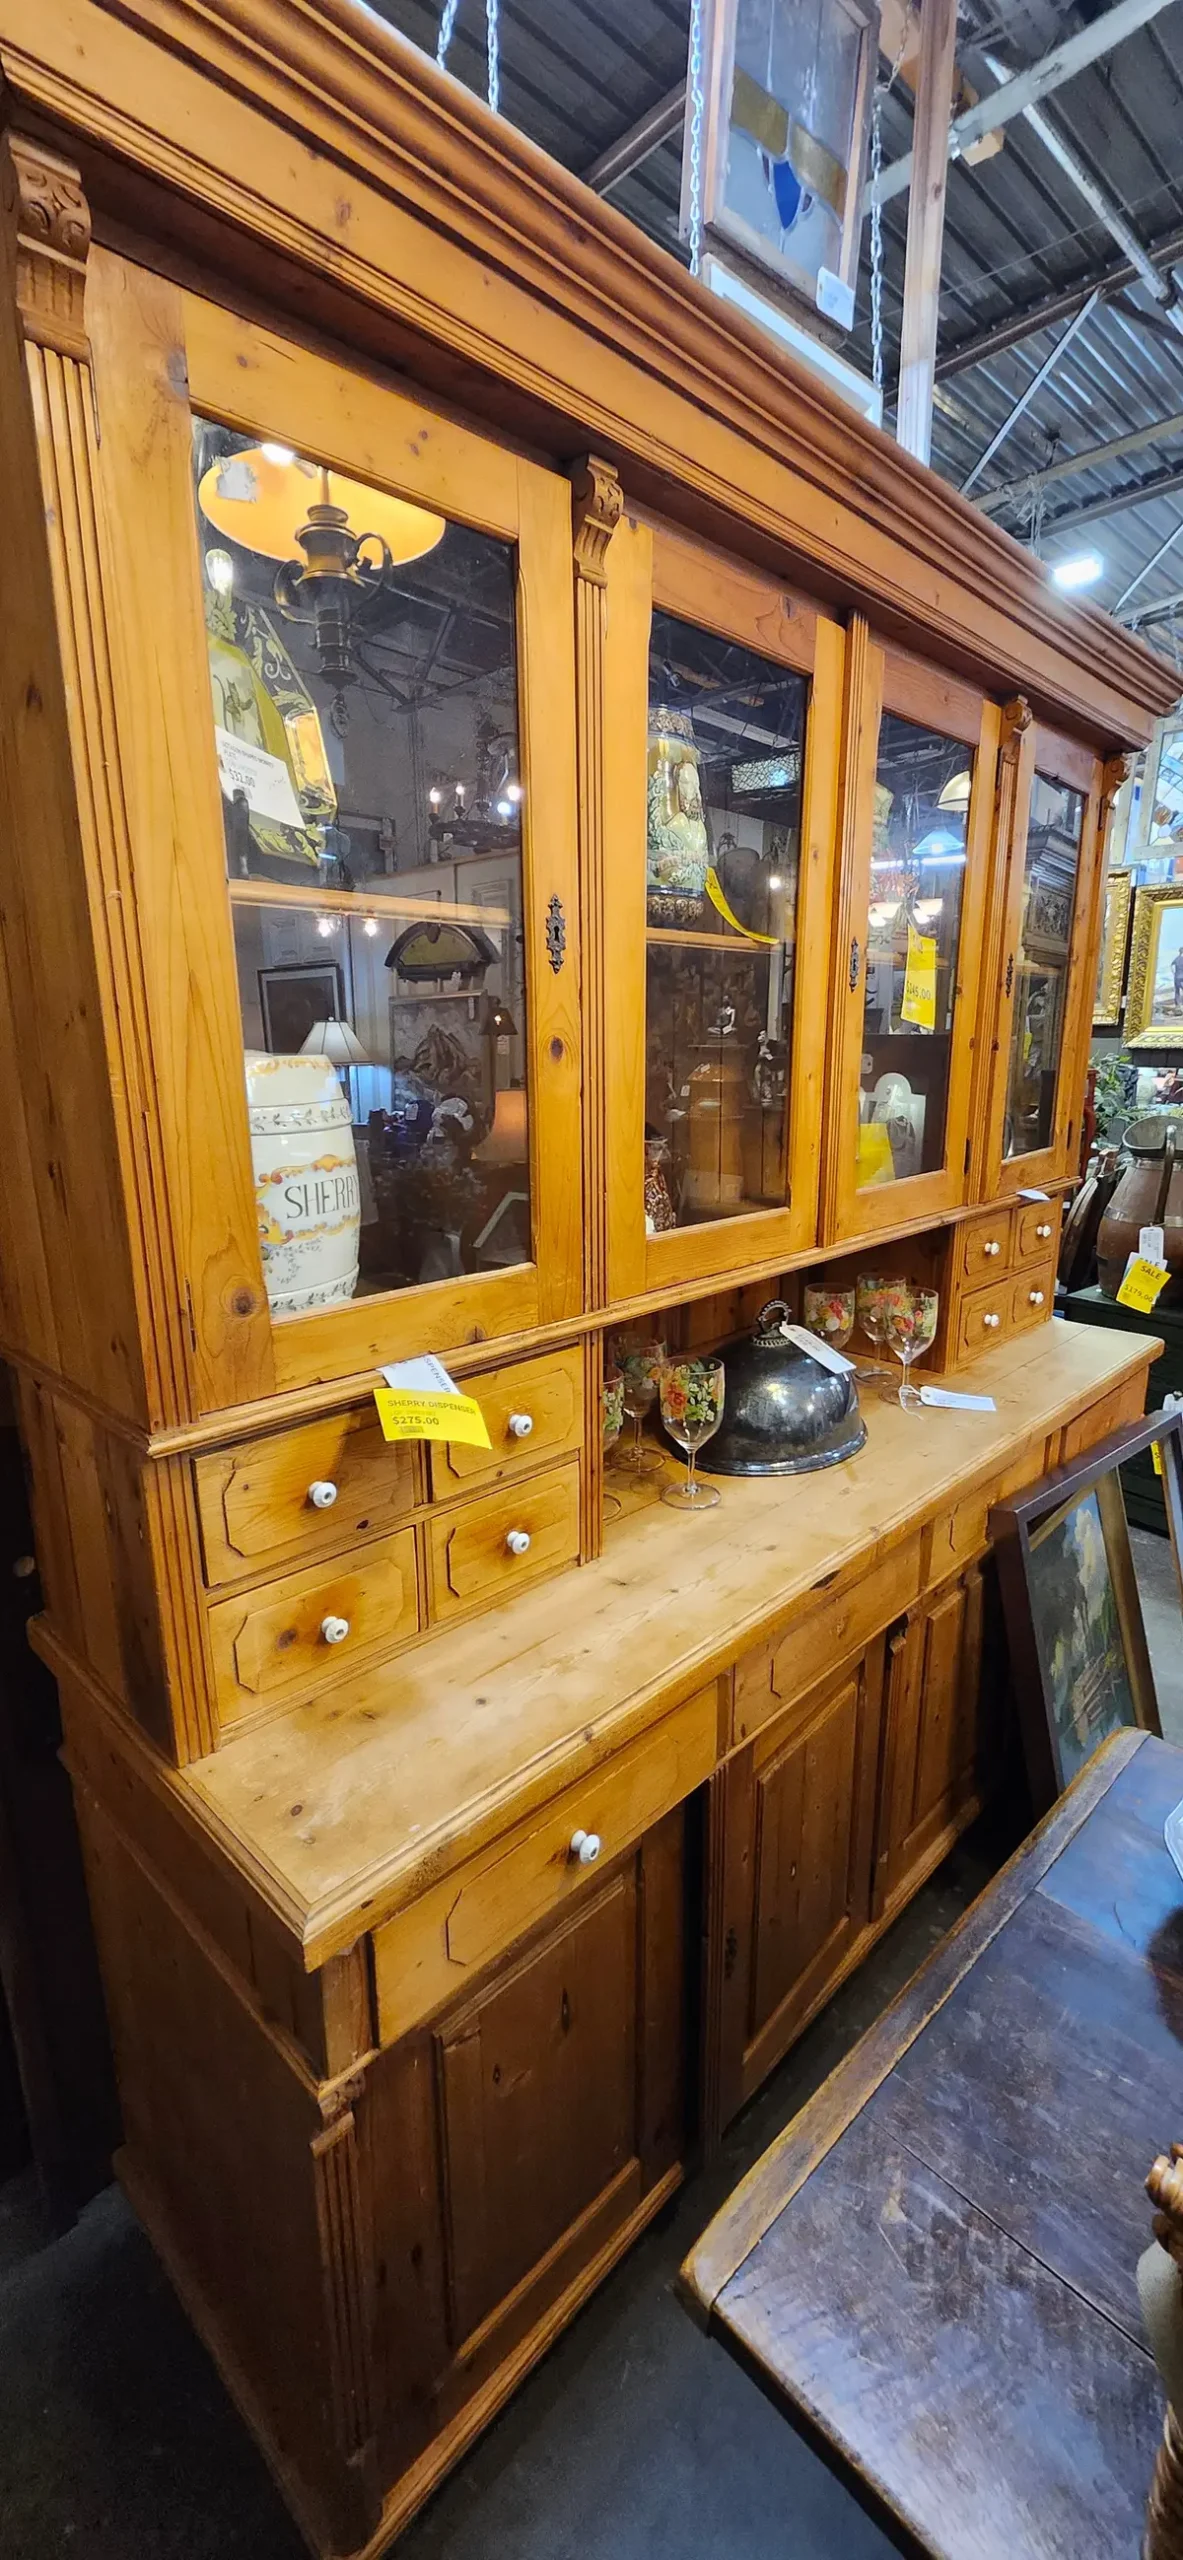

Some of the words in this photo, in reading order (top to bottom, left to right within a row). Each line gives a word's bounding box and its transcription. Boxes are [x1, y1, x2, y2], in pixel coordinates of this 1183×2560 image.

[1140, 1265, 1162, 1280] SALE
[387, 1399, 426, 1408] SHERRY
[429, 1401, 477, 1416] DISPENSER
[392, 1415, 440, 1426] $275.00
